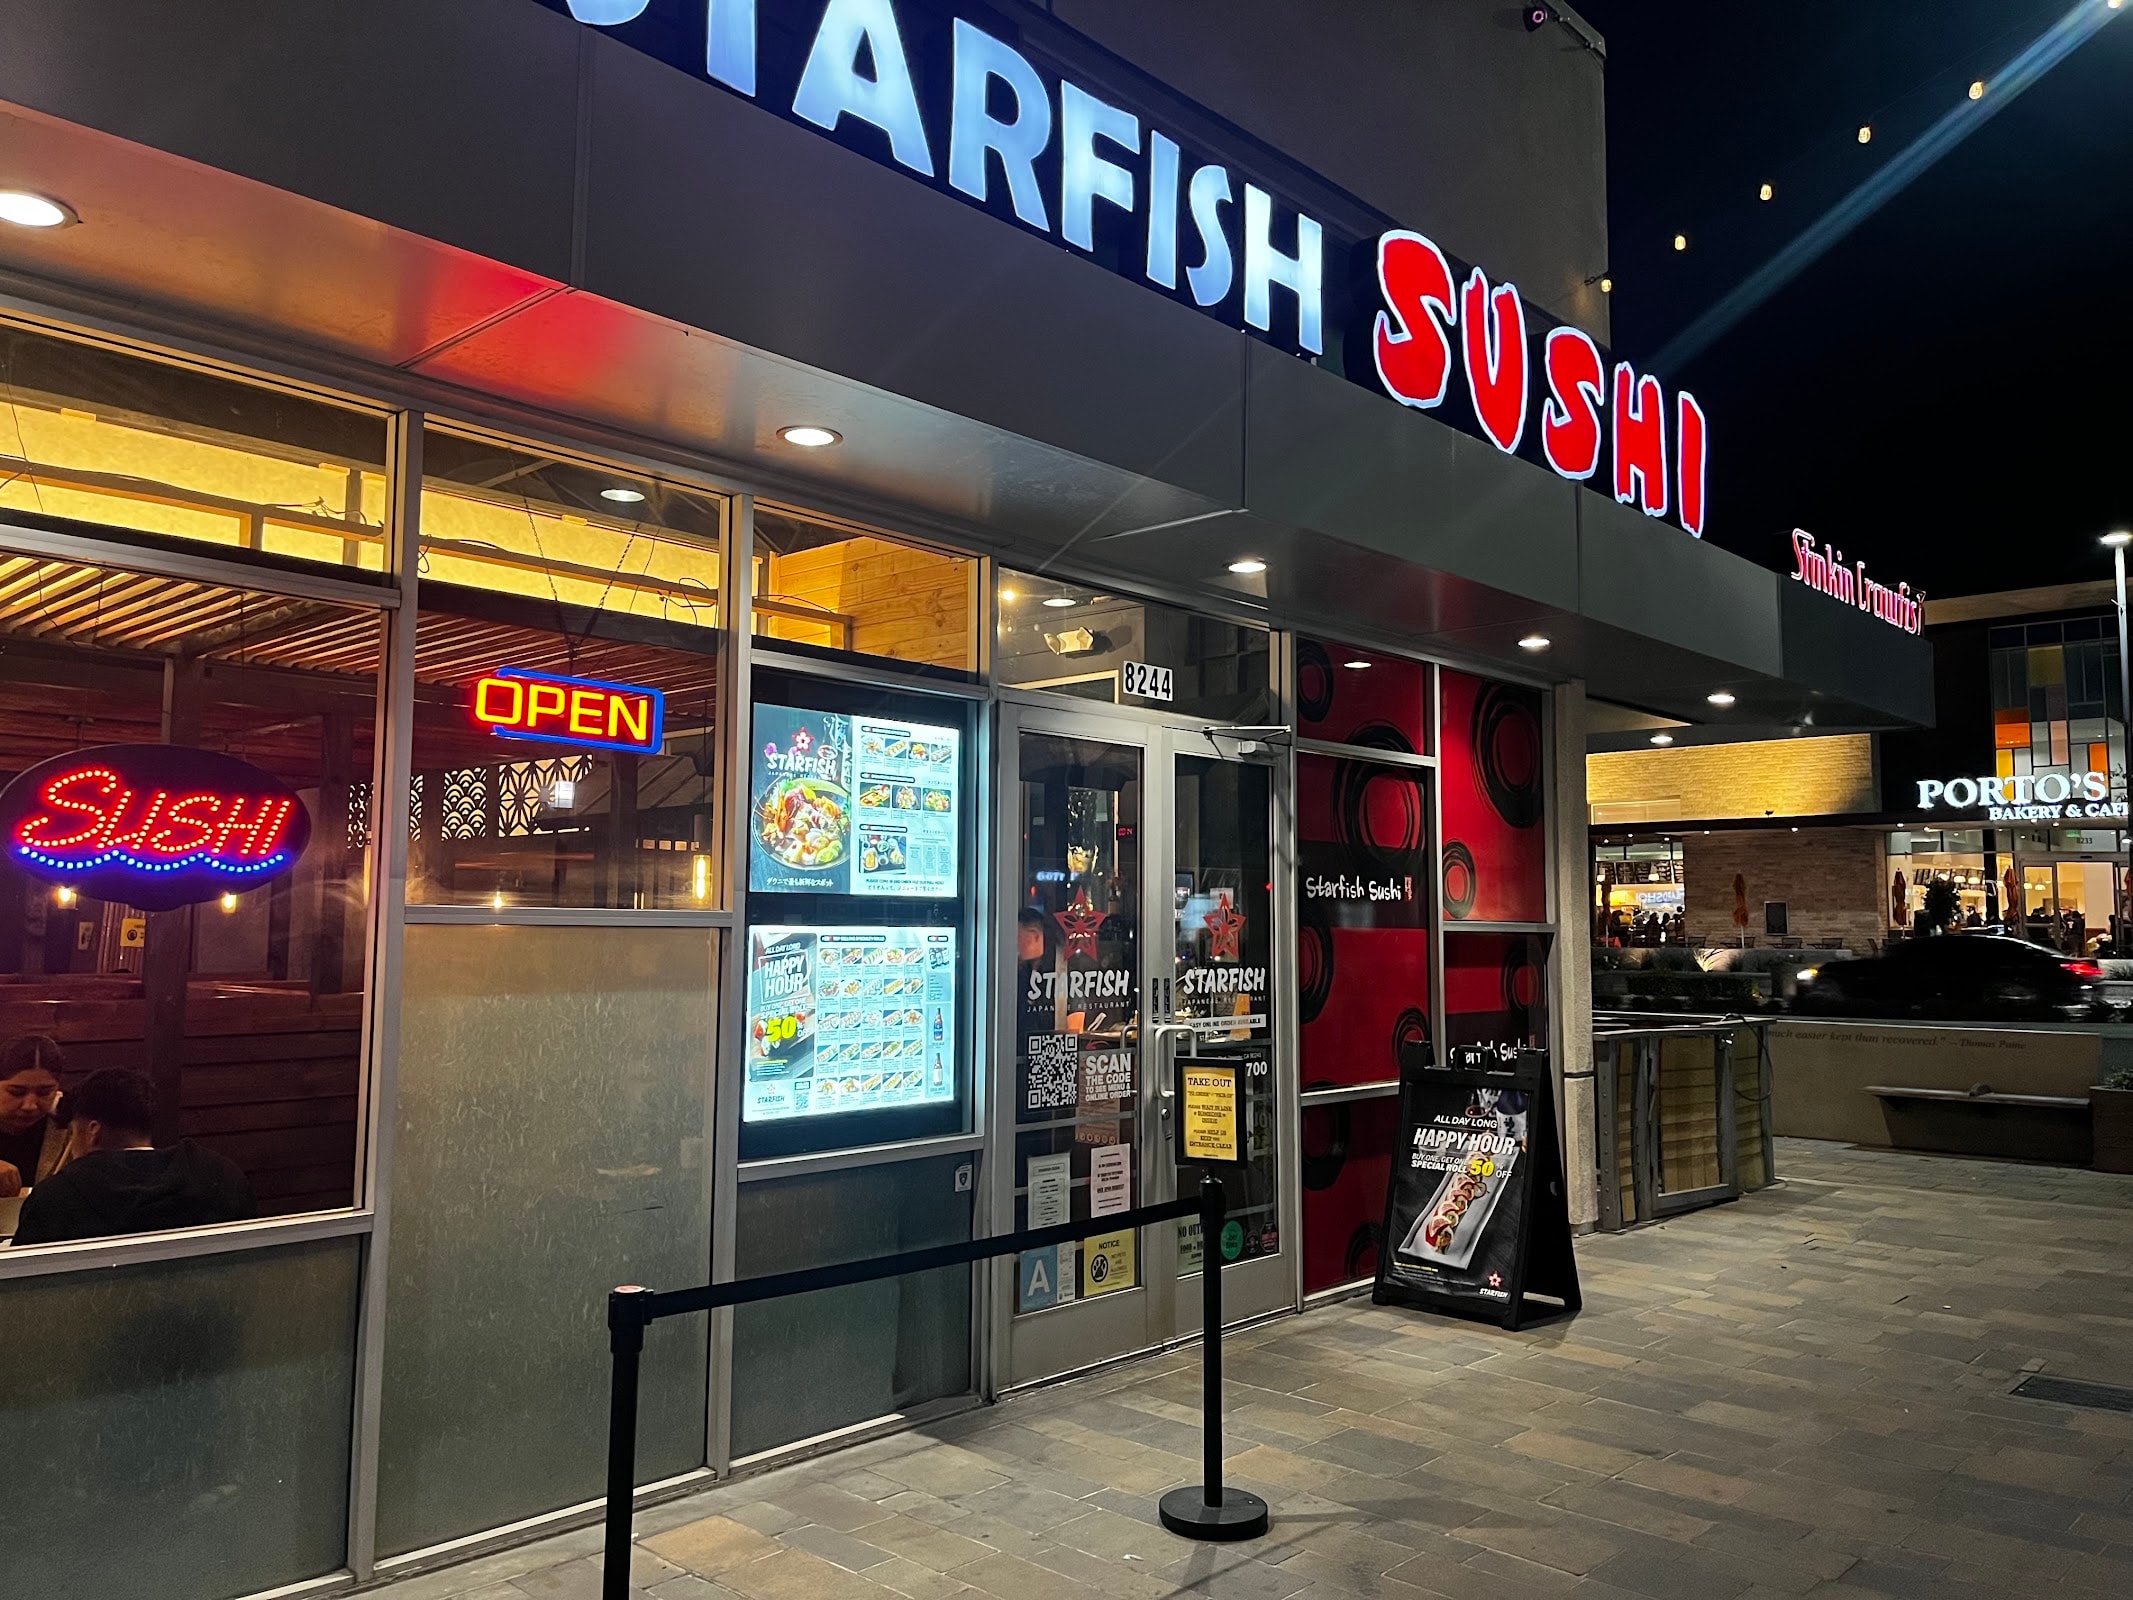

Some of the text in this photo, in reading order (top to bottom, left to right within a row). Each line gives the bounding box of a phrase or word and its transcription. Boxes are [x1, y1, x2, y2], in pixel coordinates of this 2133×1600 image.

[1374, 228, 1707, 538] SUSHI
[1791, 528, 1922, 635] Stinkin Crawfis
[1124, 662, 1171, 699] 8244
[474, 677, 651, 742] OPEN
[767, 752, 837, 775] STARFISH
[1916, 771, 2107, 809] PORTO'S
[20, 767, 292, 858] SUSHI
[1988, 804, 2062, 821] BAKERY
[2065, 803, 2082, 818] &
[1305, 874, 1365, 898] Starfish
[1368, 877, 1401, 901] Sushi
[764, 955, 805, 979] HAPPY
[764, 973, 805, 999] HOUR
[1183, 967, 1266, 994] STARFISH
[766, 1015, 797, 1043] 50
[1795, 1031, 1827, 1041] easier
[1829, 1031, 1851, 1043] kept
[1855, 1031, 1879, 1043] than
[1085, 1053, 1131, 1075] SCAN
[1085, 1072, 1131, 1086] THE CODE
[1085, 1086, 1094, 1094] TO
[1107, 1083, 1125, 1091] MENU
[1187, 1077, 1232, 1087] TAKE OUT
[1085, 1090, 1131, 1102] ONLINE ORDER
[1434, 1114, 1498, 1129] ALL DAY LONG
[1189, 1140, 1216, 1148] ENTRANCE
[1413, 1128, 1516, 1155] HAPPY HOUR
[1410, 1159, 1468, 1174] SPECIAL ROLL
[1469, 1159, 1495, 1177] 50
[1495, 1169, 1513, 1179] OFF
[1098, 1239, 1120, 1250] NOTICE
[1027, 1259, 1051, 1297] A
[1479, 1287, 1509, 1298] STARFISH
